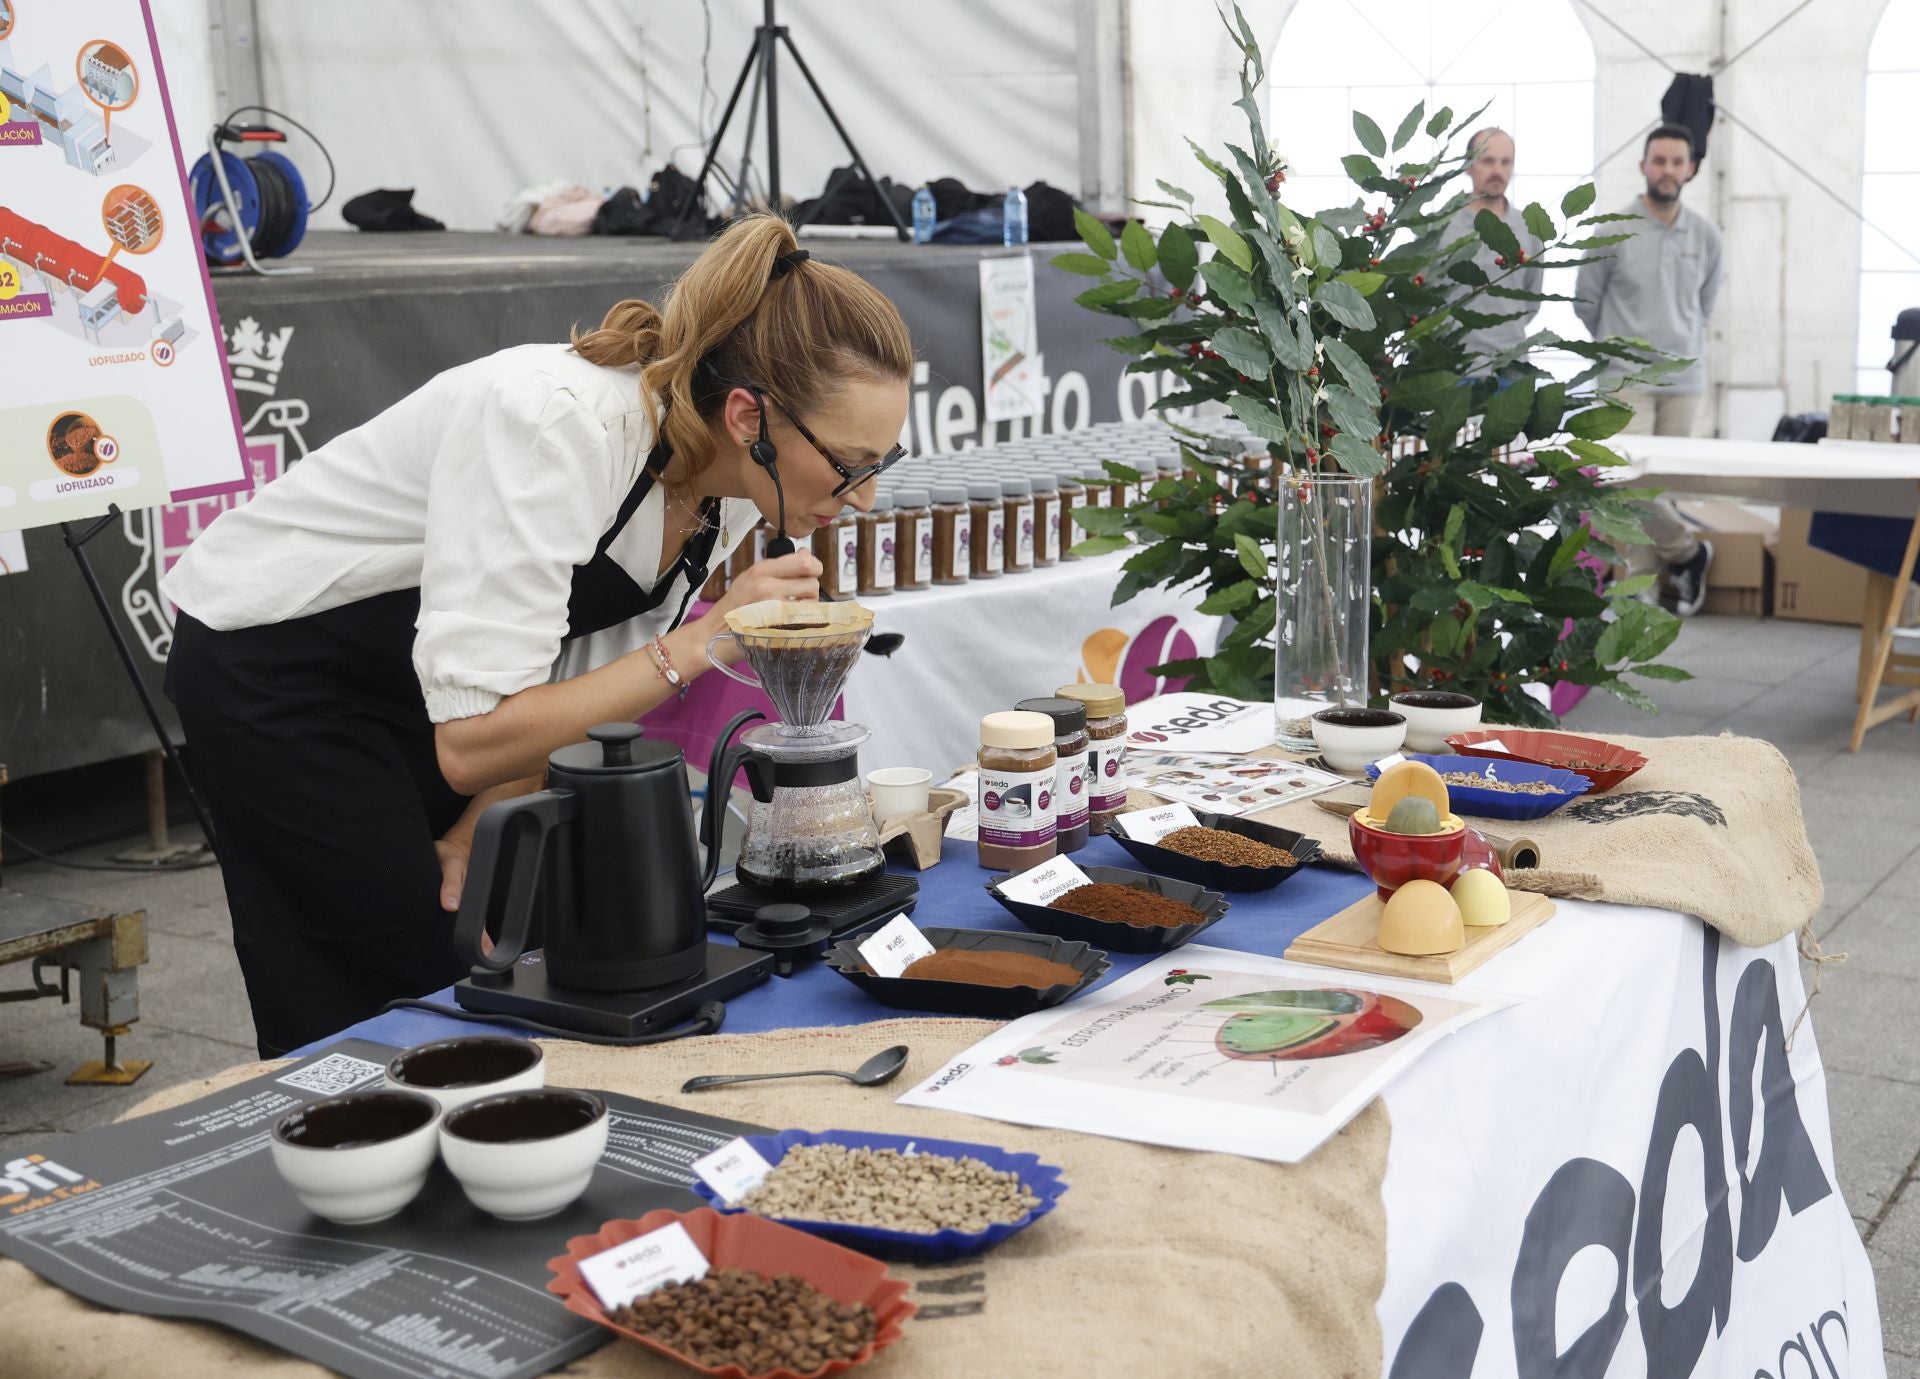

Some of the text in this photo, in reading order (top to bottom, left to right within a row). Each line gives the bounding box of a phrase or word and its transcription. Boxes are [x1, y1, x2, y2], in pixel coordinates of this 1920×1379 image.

[89, 351, 146, 367] LIOFILIZADO
[56, 475, 115, 493] LIOFILIZADO
[1151, 700, 1251, 735] seda
[990, 780, 1009, 788] seda
[1155, 811, 1174, 821] seda
[1037, 868, 1057, 882] seda
[1039, 877, 1079, 901] AGLOMERADO
[1061, 1009, 1137, 1047] ESTRUCTURA
[935, 1063, 971, 1086] seda
